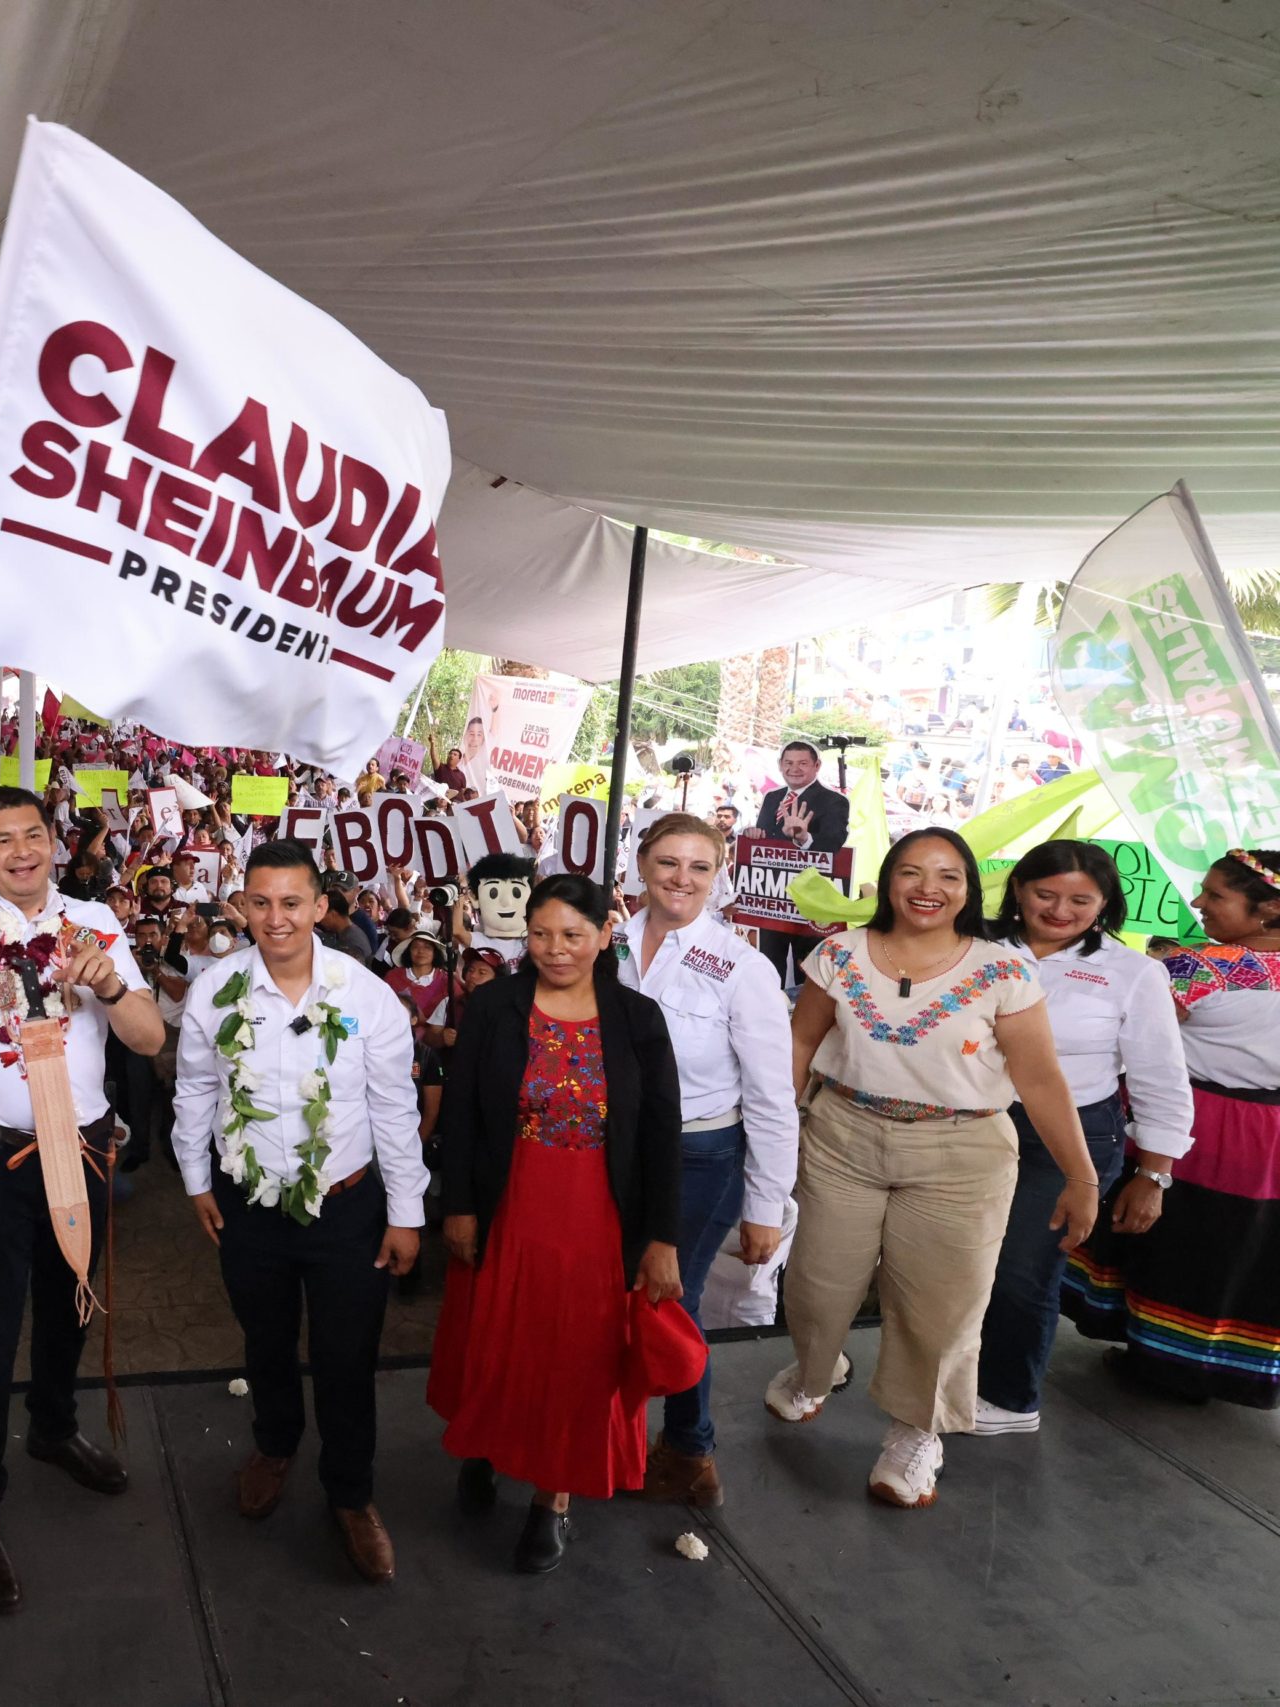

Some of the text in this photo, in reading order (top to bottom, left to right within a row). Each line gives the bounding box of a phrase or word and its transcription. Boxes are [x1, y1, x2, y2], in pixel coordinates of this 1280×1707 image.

[38, 320, 444, 597] CLAUDIA
[9, 420, 445, 653] SHEINBAUM
[118, 549, 330, 665] PRESIDENT
[513, 687, 548, 704] morena
[523, 732, 548, 747] VOTA
[490, 746, 556, 780] ARMEN
[752, 846, 831, 865] ARMENTA
[747, 907, 792, 921] GOBERNADOR
[683, 953, 731, 979] BALLESTEROS
[688, 945, 736, 972] MARILYN
[1064, 972, 1110, 987] MARTINEZ
[1071, 969, 1106, 981] ESTHER
